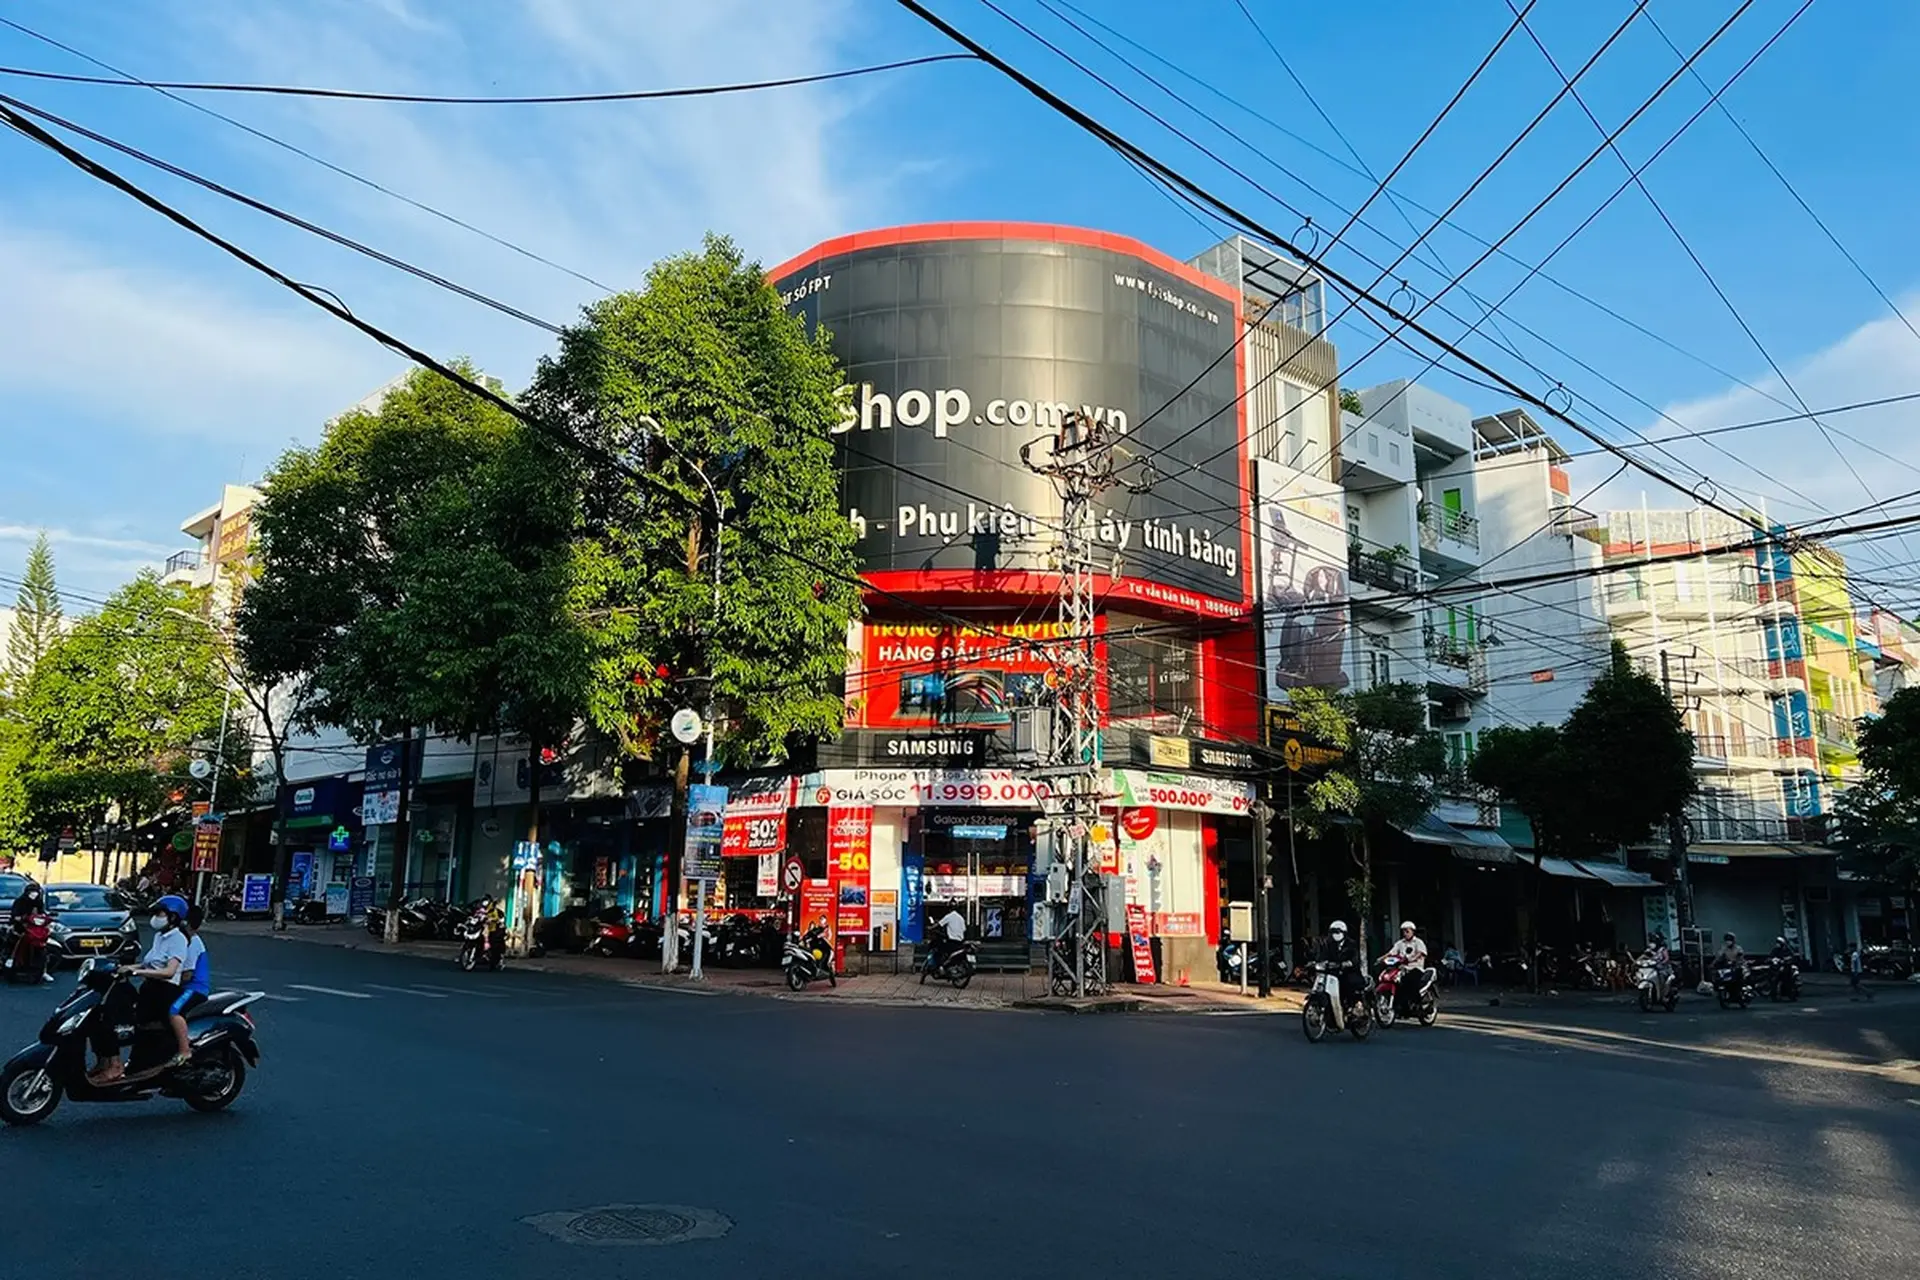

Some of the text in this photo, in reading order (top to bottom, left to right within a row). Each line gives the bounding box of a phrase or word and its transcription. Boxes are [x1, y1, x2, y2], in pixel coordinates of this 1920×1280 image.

[794, 277, 807, 301] SỐ
[808, 275, 832, 295] FPT
[831, 381, 1128, 439] Shop.comvn
[898, 503, 959, 544] Phụ
[1143, 518, 1184, 556] tính
[1190, 527, 1237, 577] bảng
[872, 622, 943, 638] TRUNG
[878, 642, 935, 662] HÀNG
[887, 740, 974, 756] SAMSUNG
[854, 770, 907, 781] iPhone
[836, 787, 864, 801] GIÁ
[870, 783, 906, 801] SỐC
[933, 814, 1018, 828] Galaxy S22 Series
